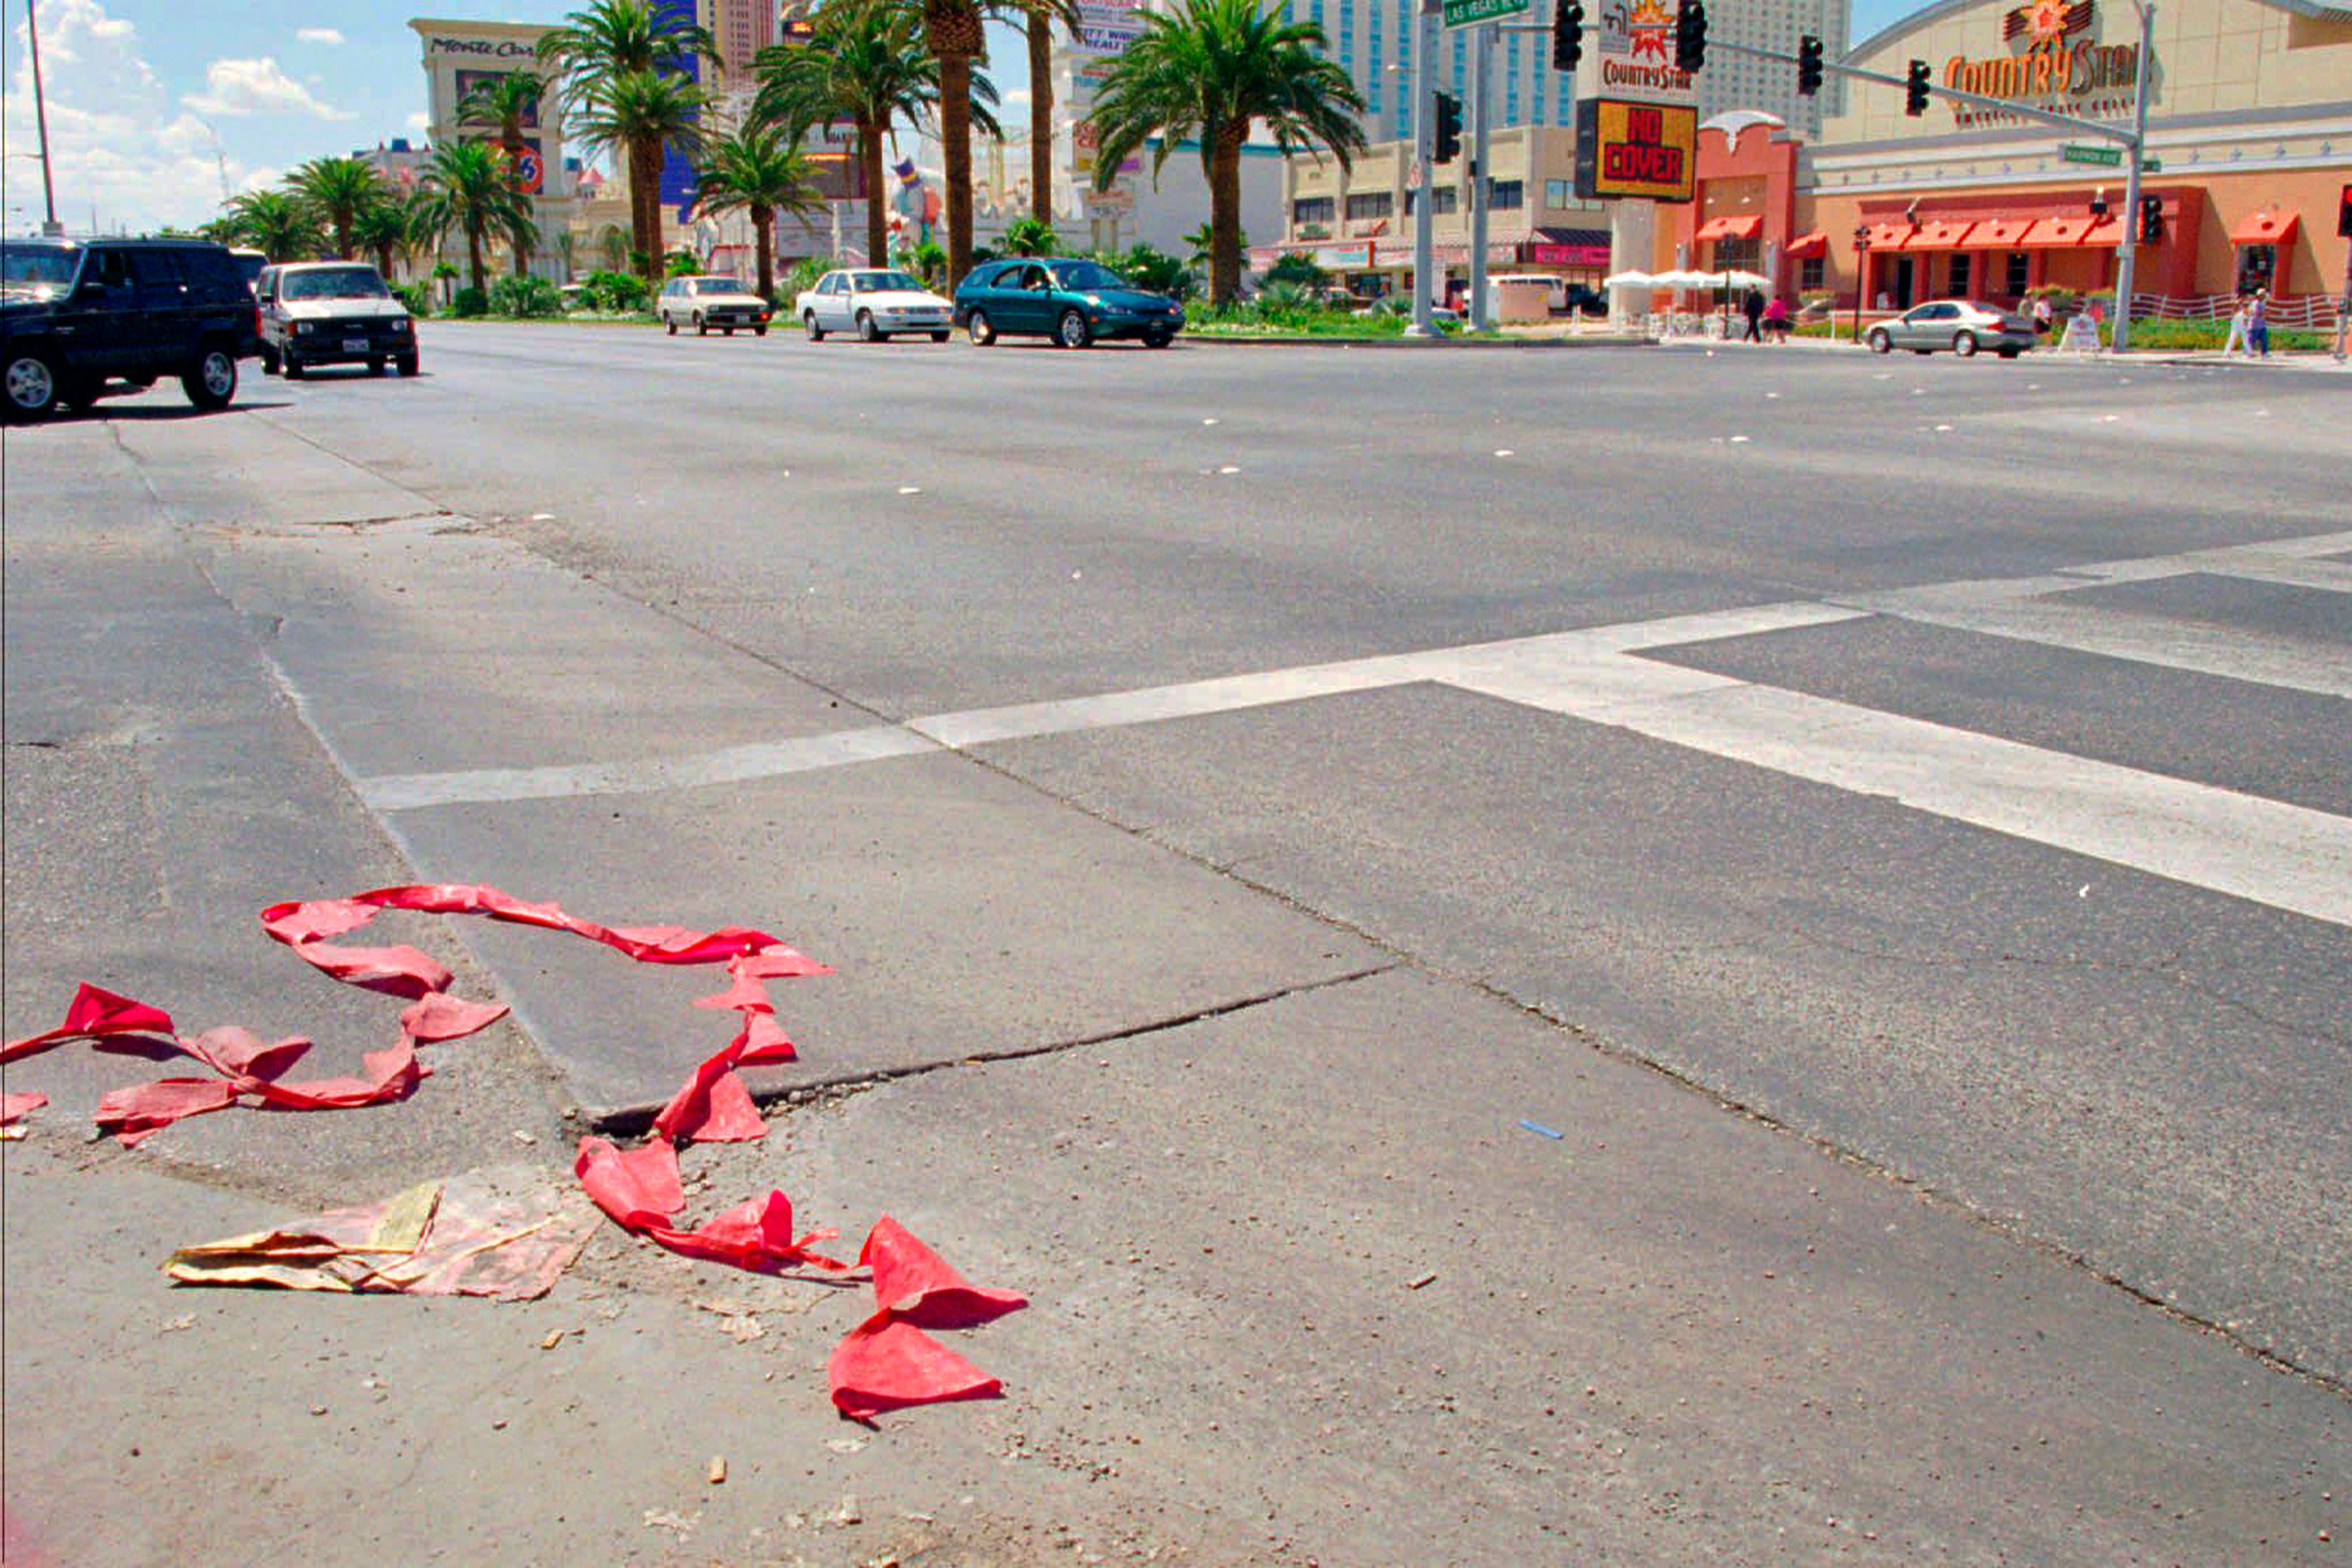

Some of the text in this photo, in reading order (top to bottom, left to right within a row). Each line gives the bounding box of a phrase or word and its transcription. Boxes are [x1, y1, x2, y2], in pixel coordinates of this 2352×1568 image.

[1447, 4, 1466, 22] LAS
[1469, 0, 1499, 16] VEGAS
[1944, 47, 2072, 109] COUNTRY
[1630, 108, 1661, 143] NO
[1606, 144, 1681, 180] COVER
